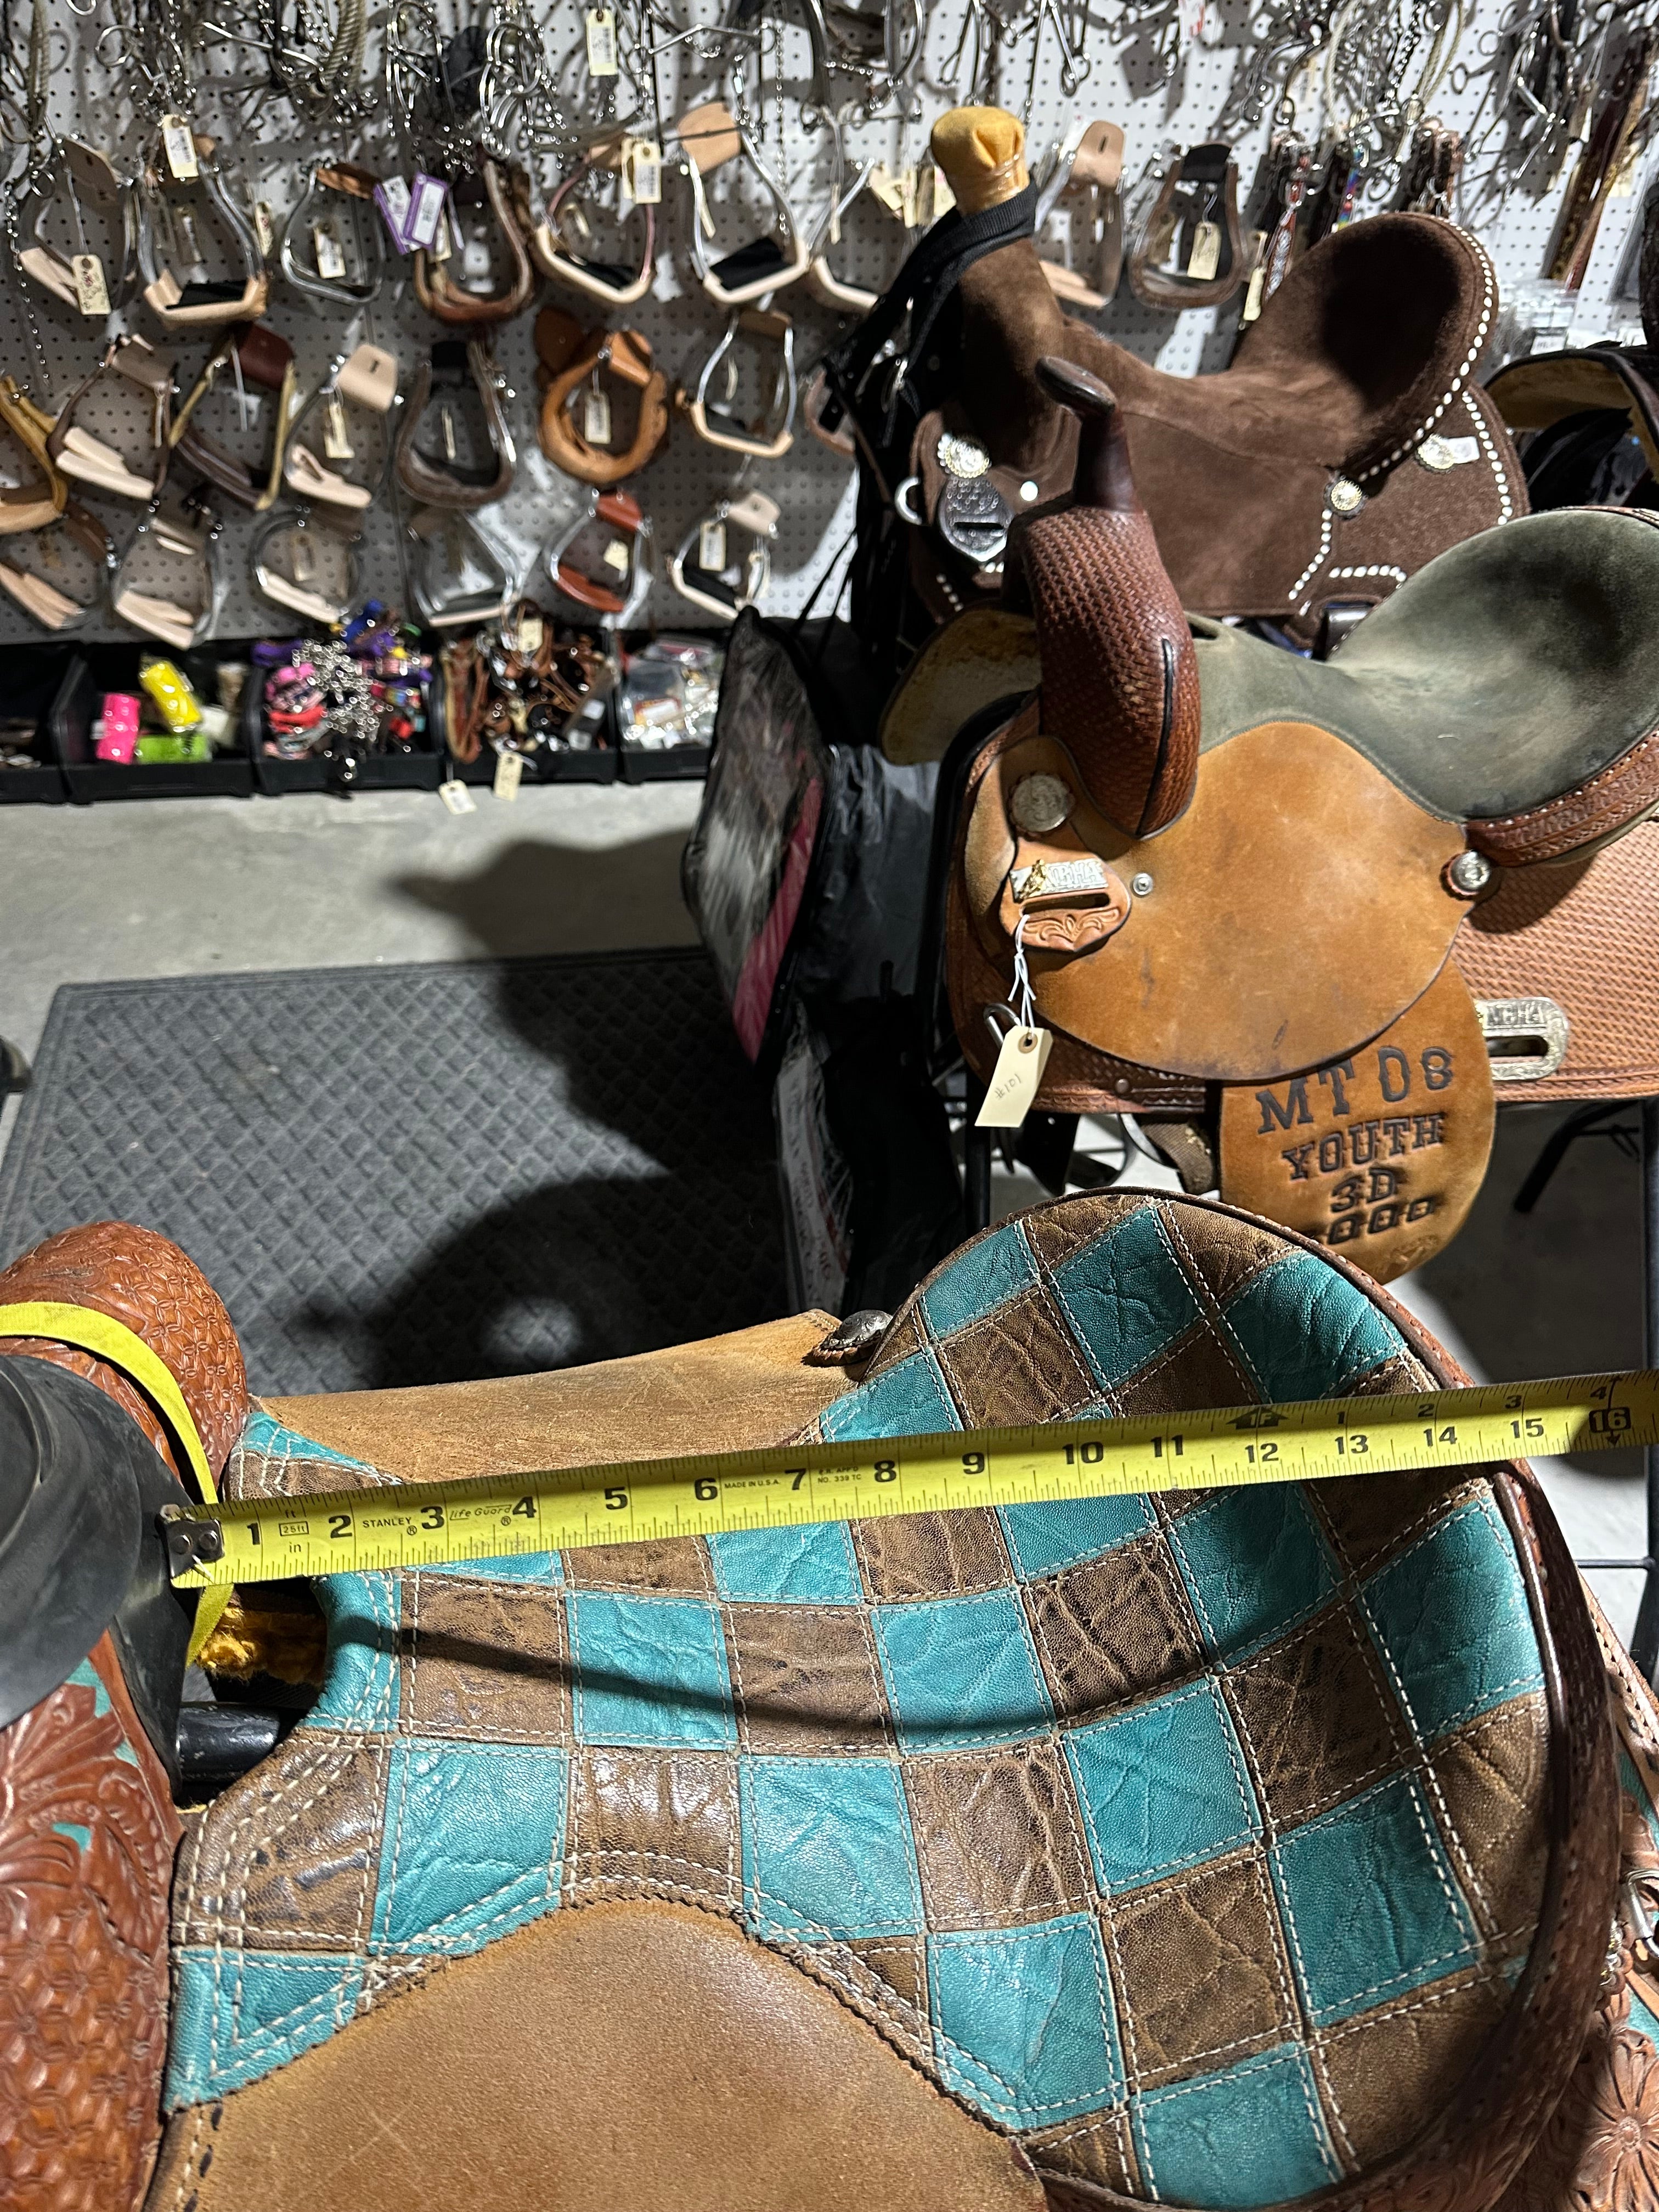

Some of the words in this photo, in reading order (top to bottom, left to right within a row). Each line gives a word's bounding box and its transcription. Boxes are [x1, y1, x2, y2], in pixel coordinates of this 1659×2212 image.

[1282, 1113, 1444, 1180] YOUTH
[1330, 1167, 1397, 1212] 3D
[1505, 1395, 1522, 1409] 3
[1590, 1387, 1607, 1400] 4
[1336, 1411, 1345, 1424] 1
[1418, 1403, 1435, 1418] 2
[1593, 1409, 1627, 1431] 16
[1423, 1426, 1458, 1447] 14
[1510, 1418, 1544, 1439] 15
[1062, 1441, 1104, 1465] 10
[1152, 1435, 1183, 1458] 11
[1245, 1442, 1279, 1464] 12
[1335, 1435, 1369, 1455] 13
[874, 1460, 896, 1482] 8
[962, 1452, 985, 1474] 9
[695, 1477, 718, 1500] 6
[785, 1468, 806, 1491] 7
[512, 1497, 537, 1518] 4
[605, 1487, 628, 1510] 5
[286, 1509, 296, 1519] ft
[363, 1517, 411, 1528] STANLEY
[421, 1506, 444, 1530] 3
[247, 1522, 261, 1545] 1
[284, 1525, 305, 1533] 25ft
[329, 1515, 352, 1538] 2
[289, 1542, 301, 1553] in
